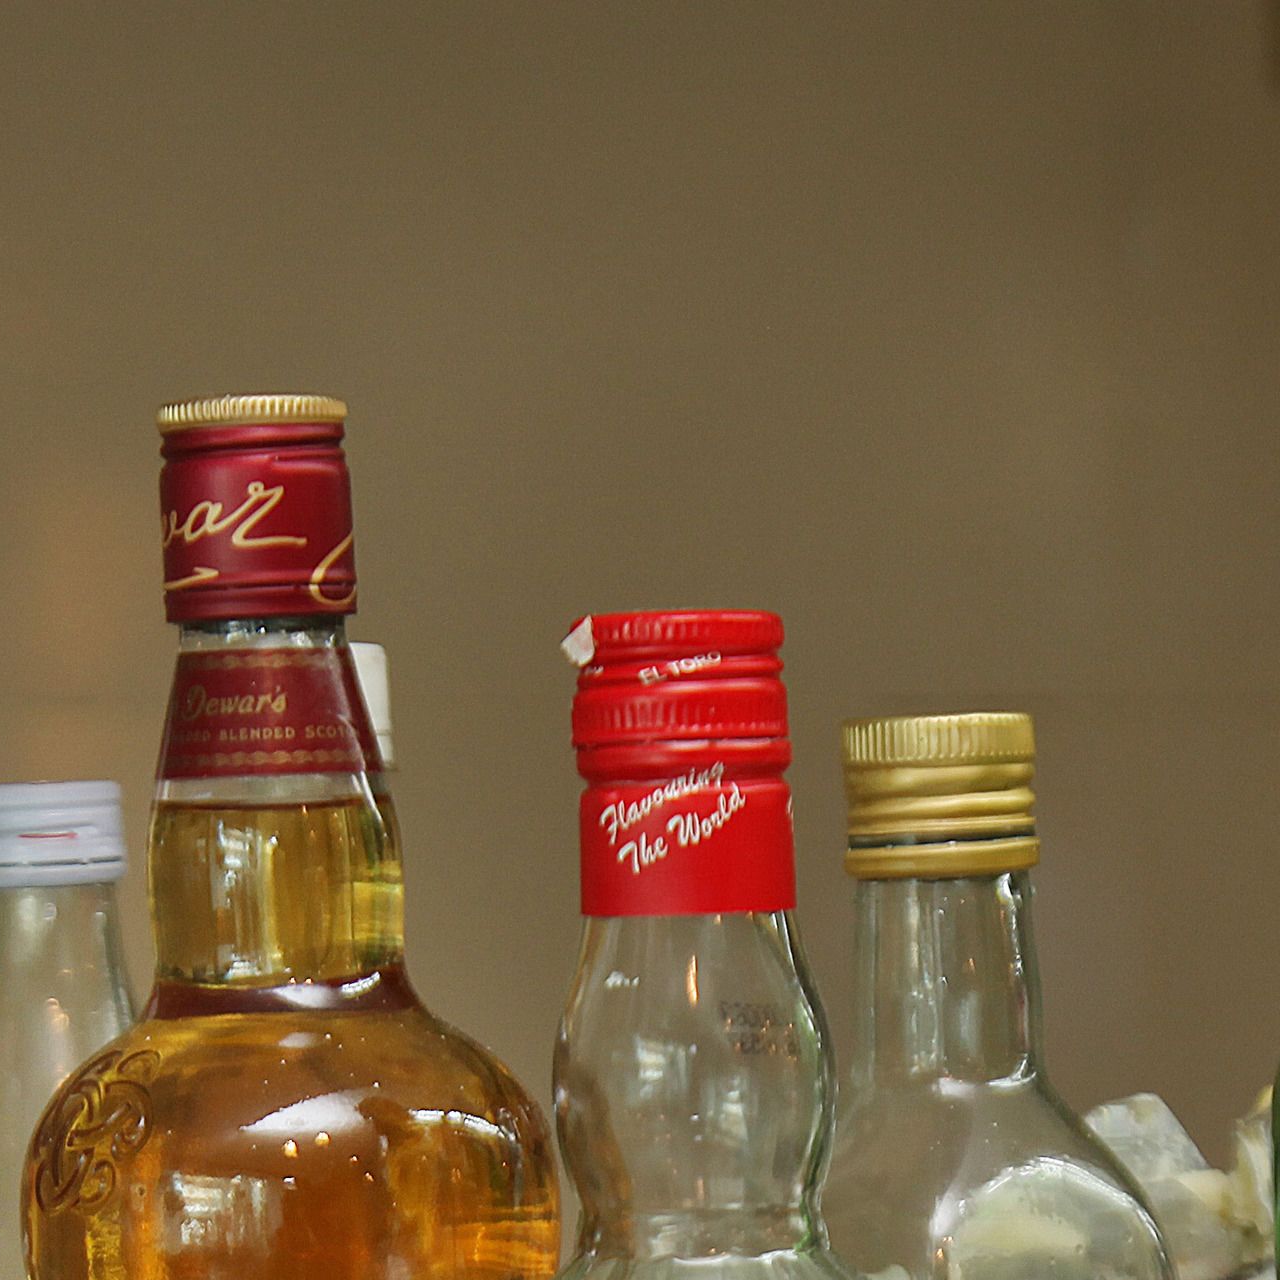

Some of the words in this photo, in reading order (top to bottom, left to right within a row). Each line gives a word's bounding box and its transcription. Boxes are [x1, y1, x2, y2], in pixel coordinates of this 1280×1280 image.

[637, 665, 668, 686] EL
[669, 651, 722, 676] TORO
[219, 725, 295, 741] BLENDED
[599, 760, 726, 845] Flavouring
[616, 831, 669, 874] The
[666, 781, 747, 847] World
